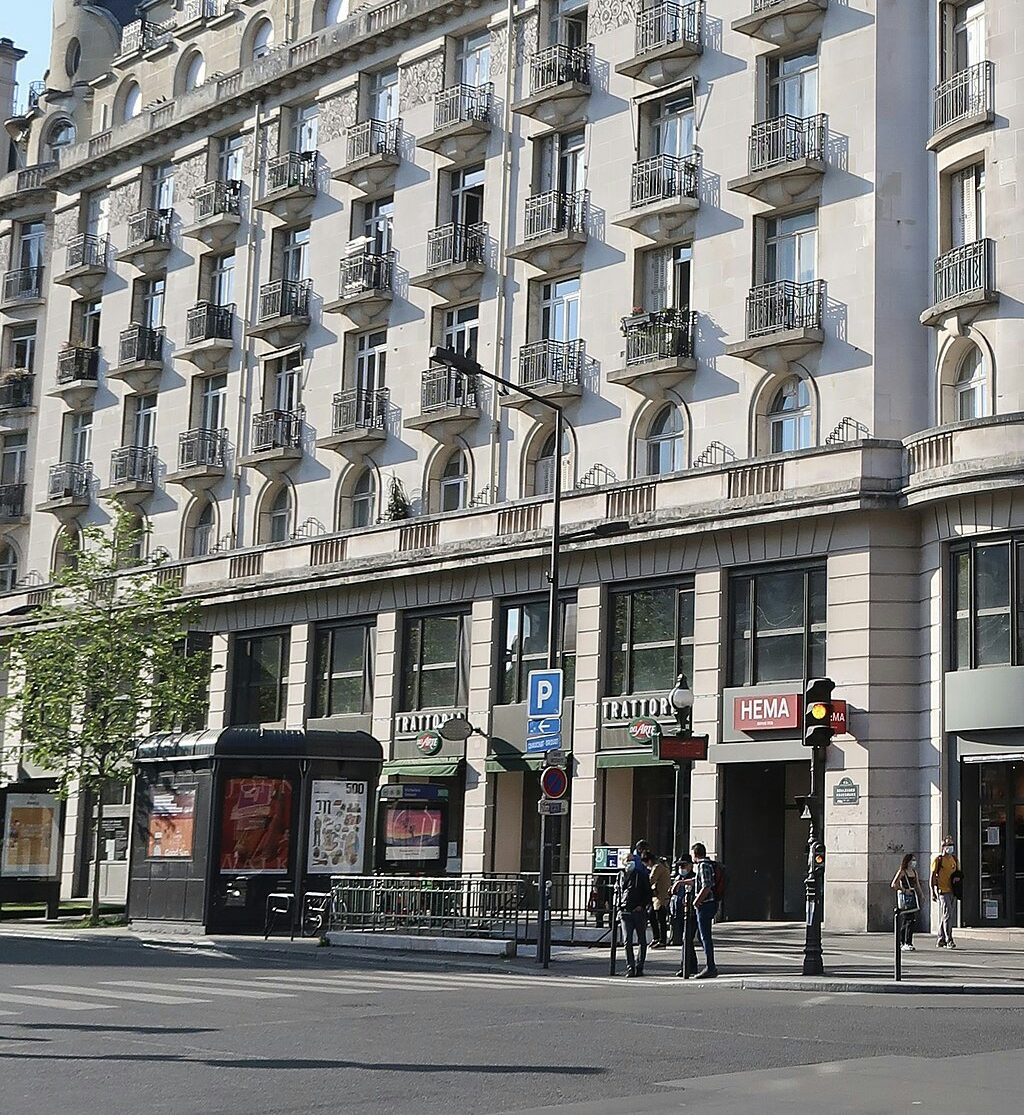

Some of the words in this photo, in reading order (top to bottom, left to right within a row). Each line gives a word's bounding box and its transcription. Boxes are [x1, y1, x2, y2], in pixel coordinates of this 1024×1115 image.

[537, 680, 552, 709] P
[741, 697, 790, 721] HEMA
[345, 782, 364, 794] 500
